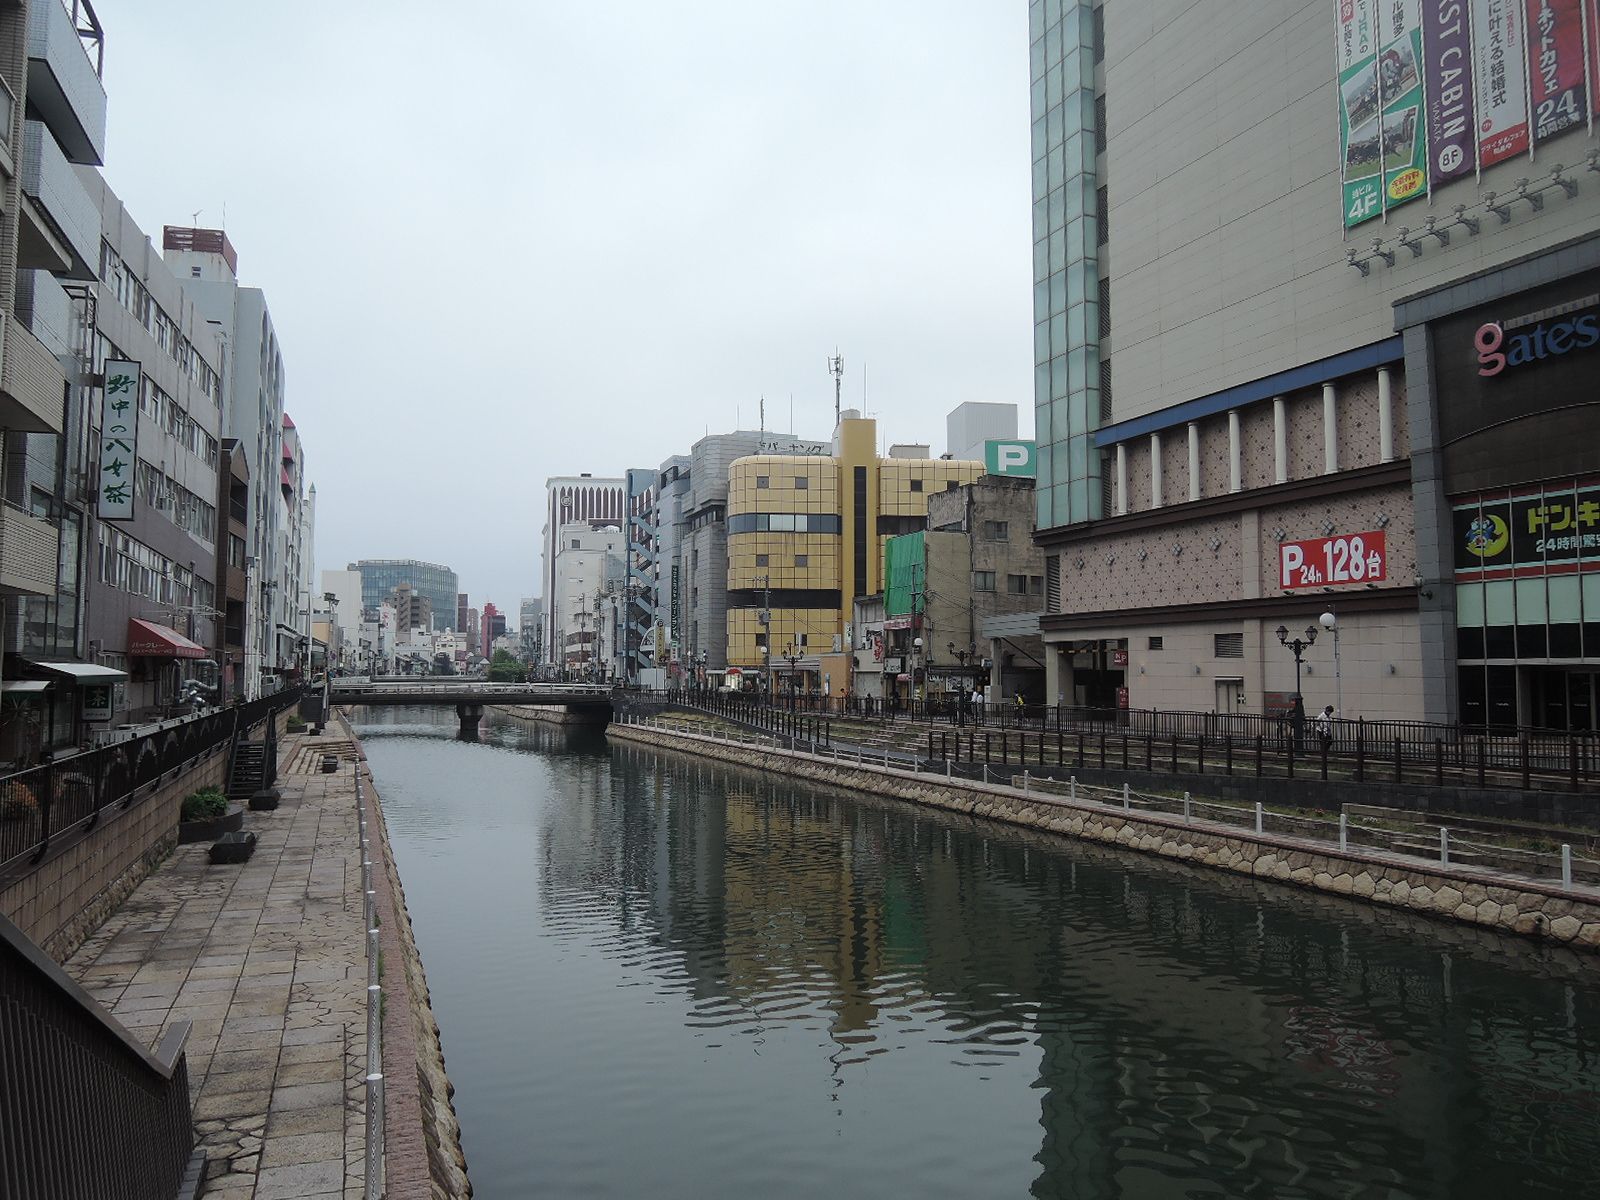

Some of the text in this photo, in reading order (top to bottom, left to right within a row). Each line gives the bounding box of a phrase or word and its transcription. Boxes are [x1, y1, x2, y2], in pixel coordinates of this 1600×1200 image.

[1440, 46, 1466, 139] CABIN
[1536, 89, 1578, 127] 24
[1432, 100, 1441, 145] HAKATA
[1442, 149, 1459, 167] 8F
[1348, 191, 1378, 218] 4F
[1474, 313, 1600, 377] gate's
[102, 374, 136, 505] 野中の八女茶
[997, 444, 1029, 472] P
[1282, 545, 1304, 586] P
[1301, 564, 1322, 584] 24h
